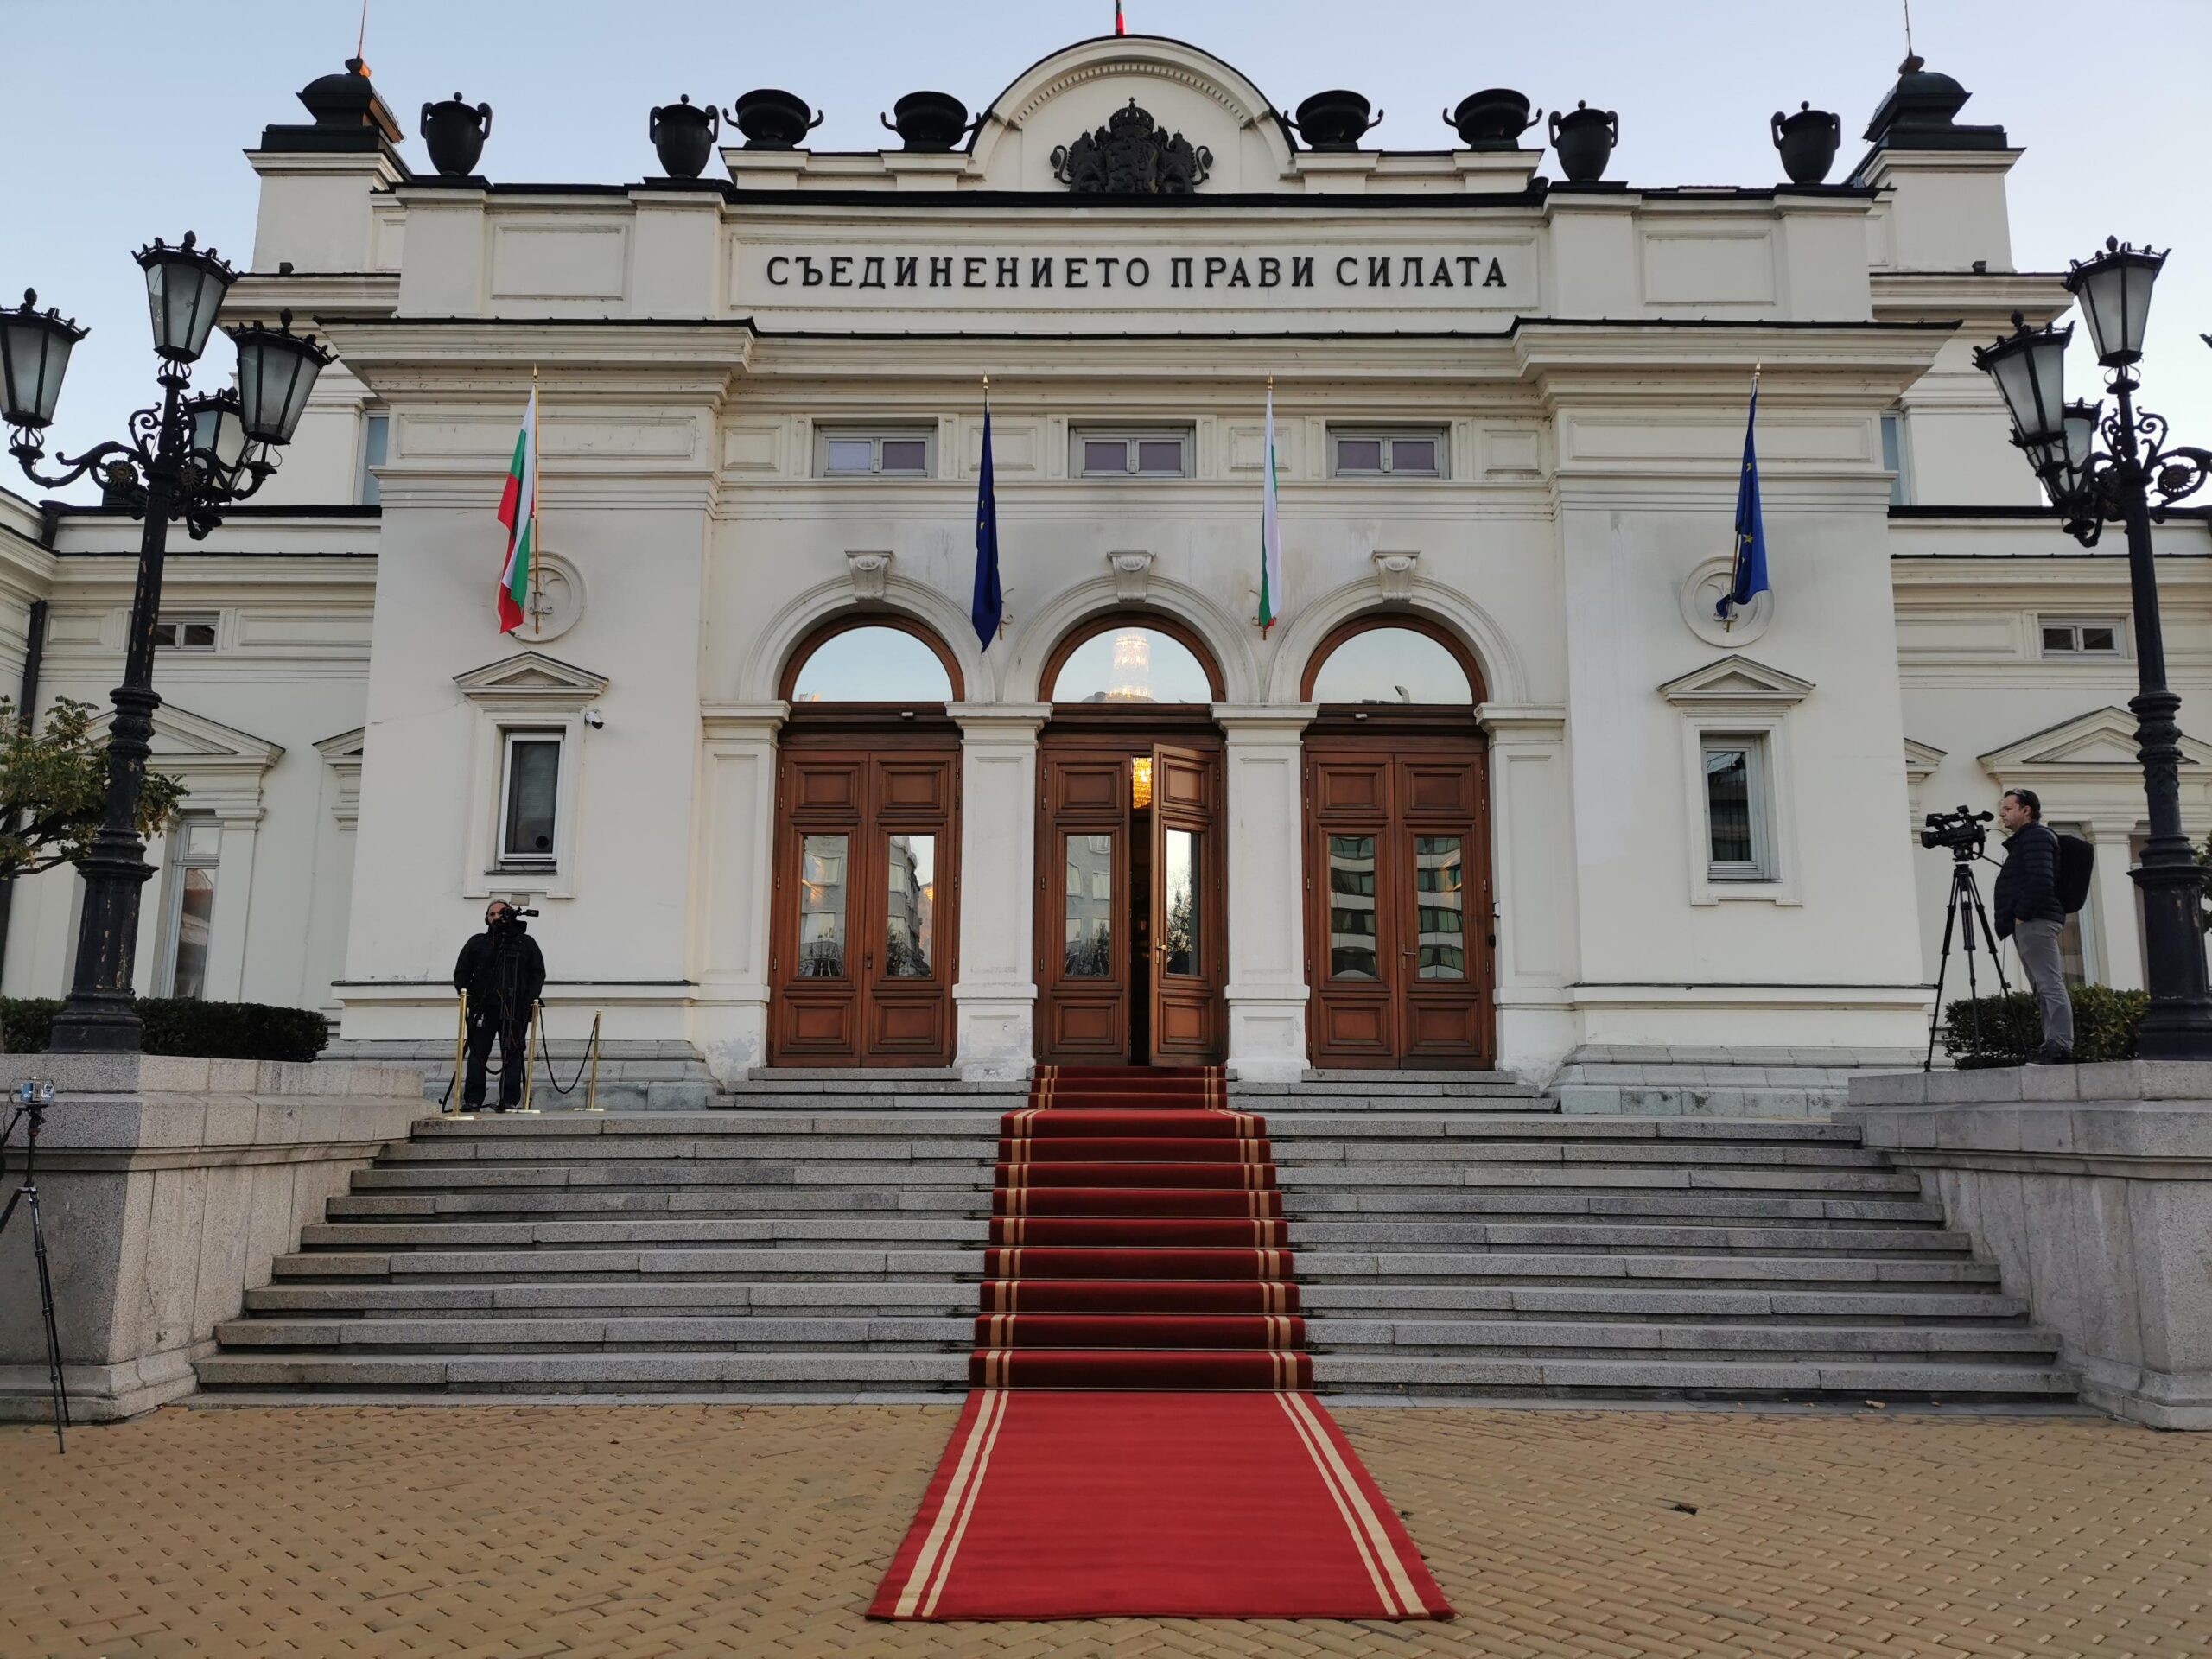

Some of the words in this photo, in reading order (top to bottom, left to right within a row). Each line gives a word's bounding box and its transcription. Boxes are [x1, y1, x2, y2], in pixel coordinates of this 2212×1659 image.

[766, 256, 1150, 289] СЪЕДИНЕНИЕТО
[1170, 257, 1314, 288] ПРАВИ
[1336, 256, 1507, 287] СИЛАТА
